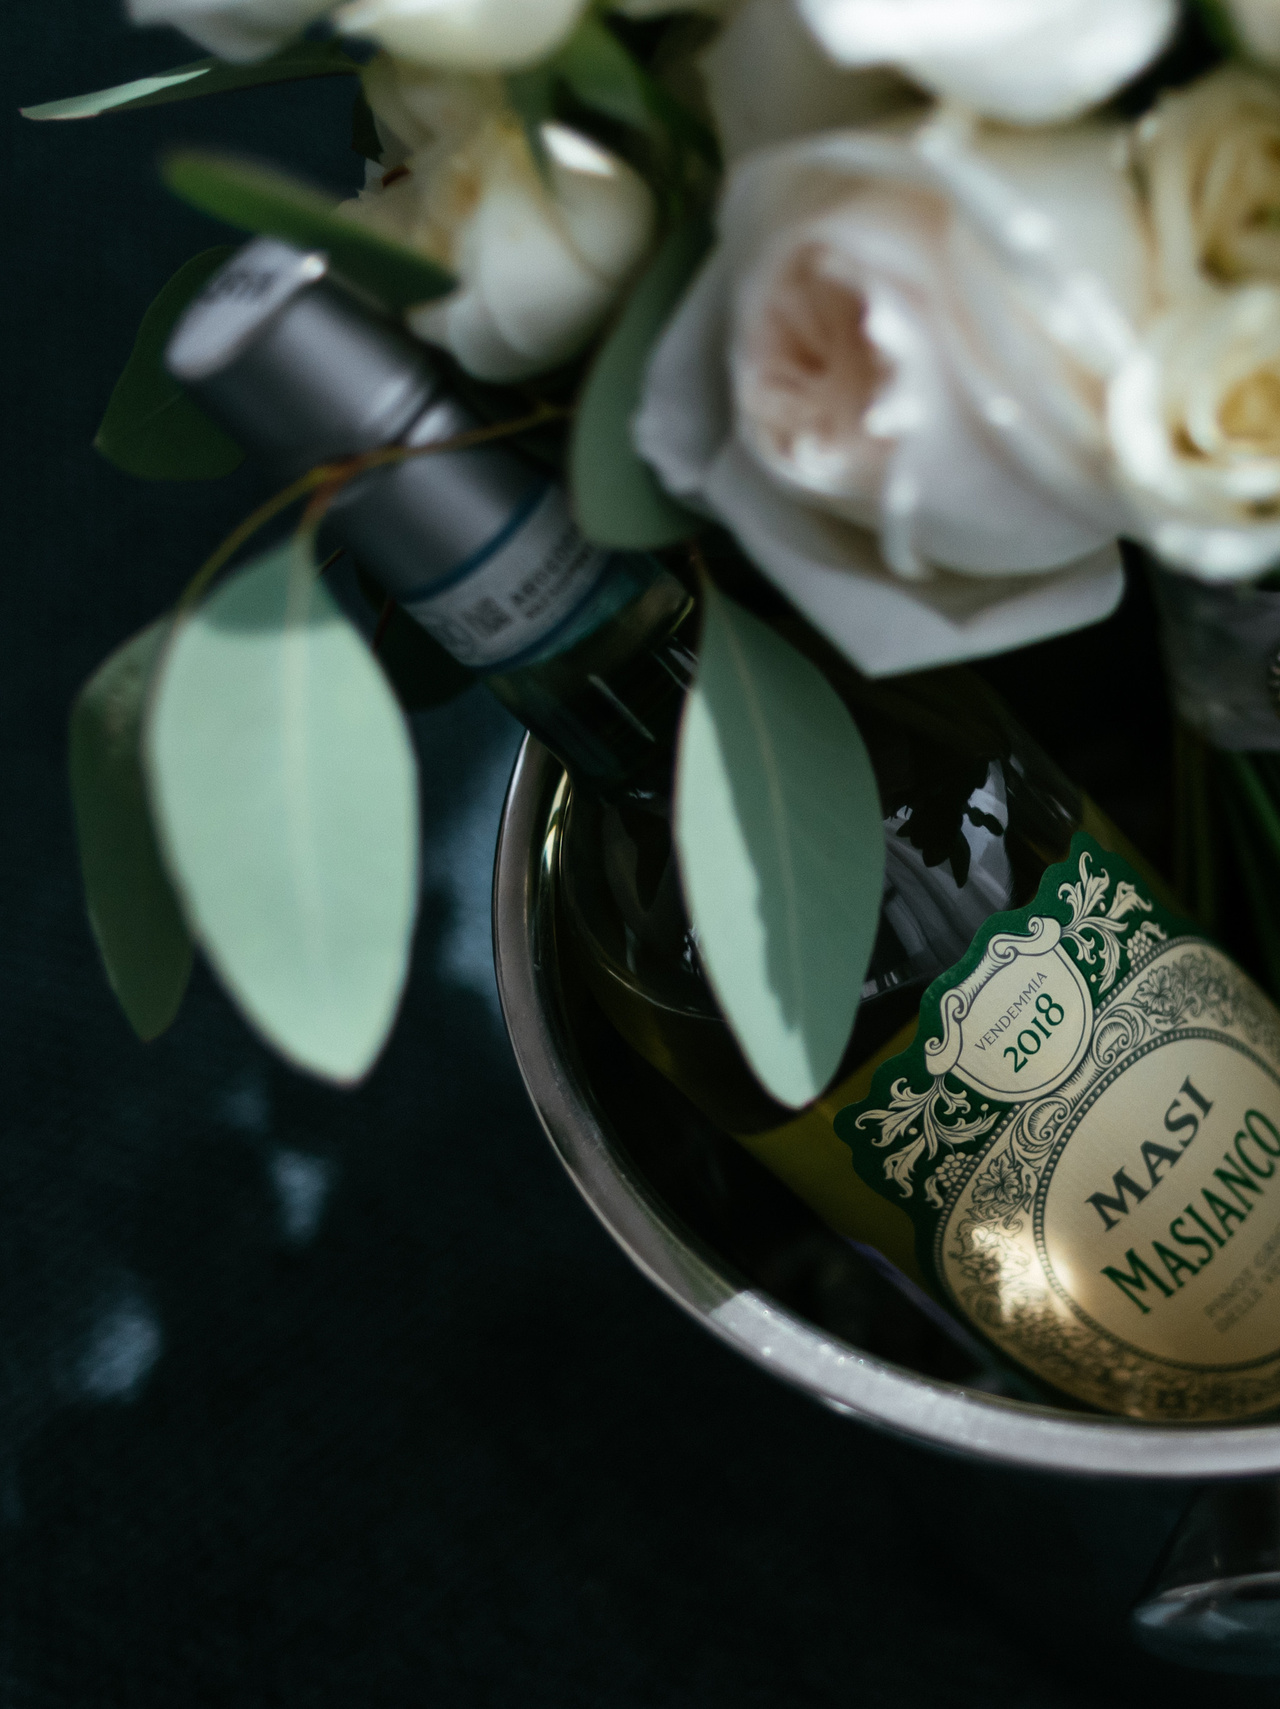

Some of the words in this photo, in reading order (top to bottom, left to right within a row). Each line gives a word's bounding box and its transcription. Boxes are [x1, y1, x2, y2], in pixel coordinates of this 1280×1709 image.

[974, 971, 1048, 1052] VENDEMMIA
[1003, 993, 1065, 1073] 2018
[1085, 1074, 1214, 1232] MASI
